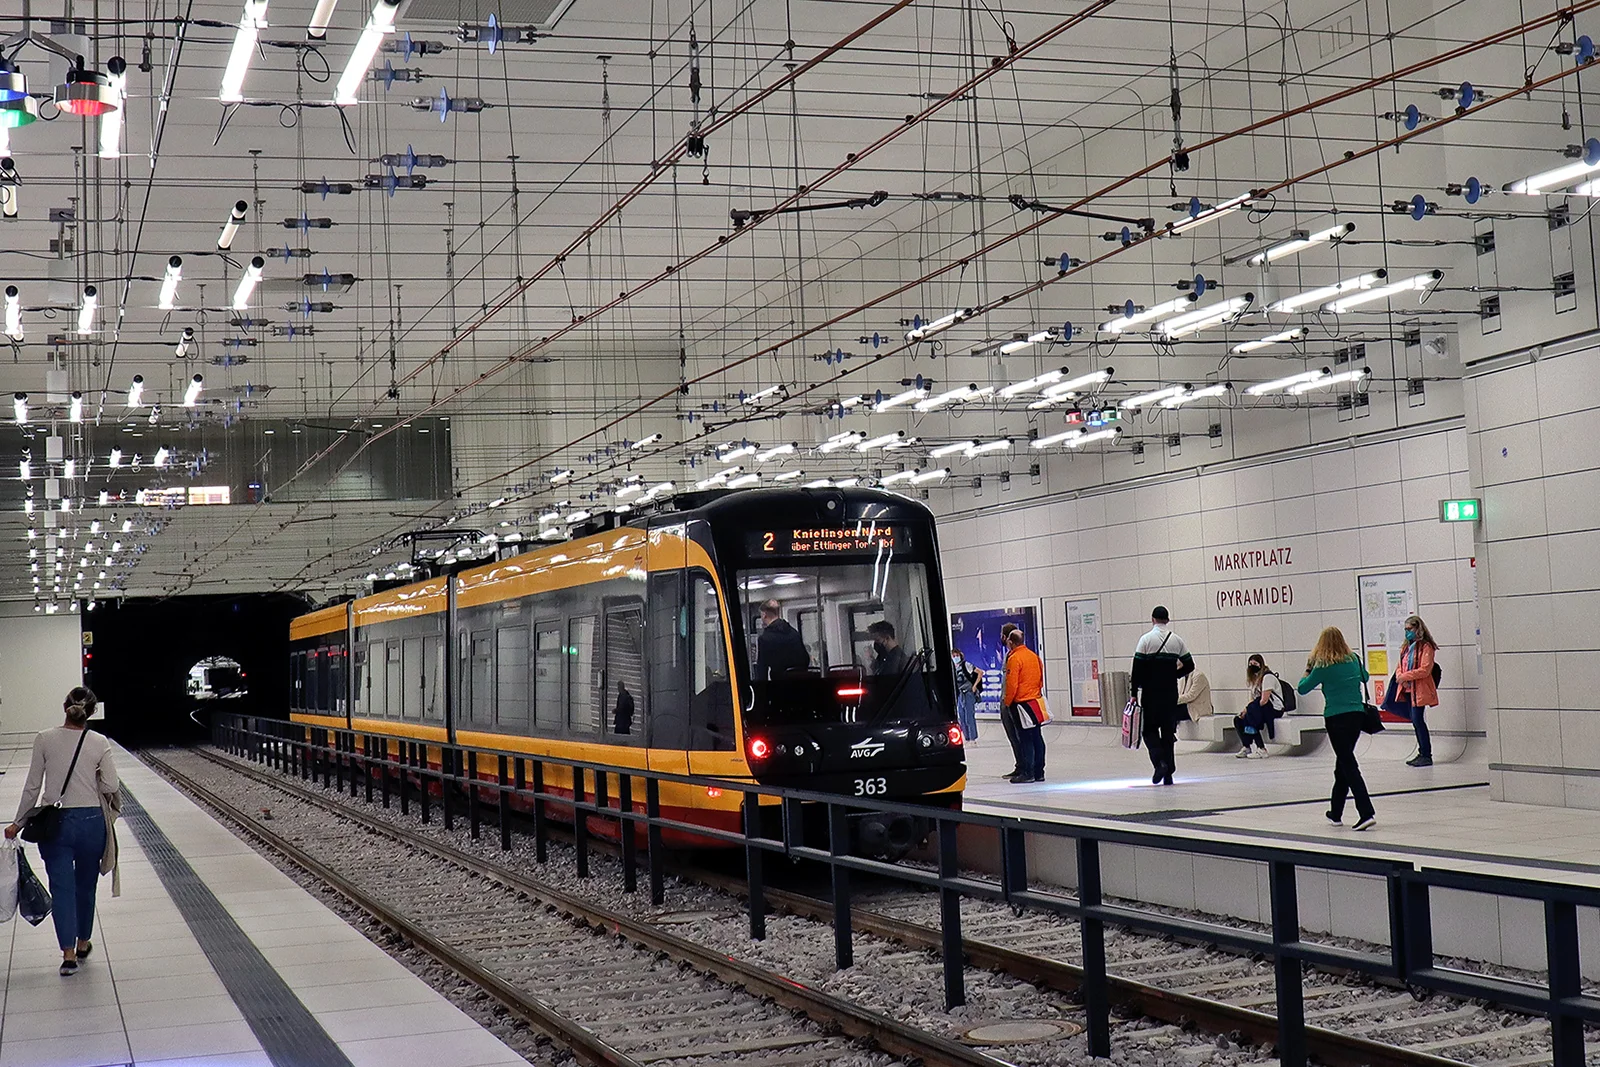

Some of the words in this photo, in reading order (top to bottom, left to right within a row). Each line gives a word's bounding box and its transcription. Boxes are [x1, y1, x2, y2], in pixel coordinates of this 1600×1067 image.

[763, 532, 774, 551] 2
[793, 528, 858, 539] Knielingen
[861, 527, 892, 537] Nord
[792, 542, 811, 551] über
[814, 540, 852, 551] Ettlinger
[855, 540, 869, 549] Tor
[1214, 547, 1292, 571] MARKTPLATZ
[1216, 584, 1293, 610] (PYRAMIDE)
[850, 748, 871, 758] AVG
[854, 777, 887, 796] 363
